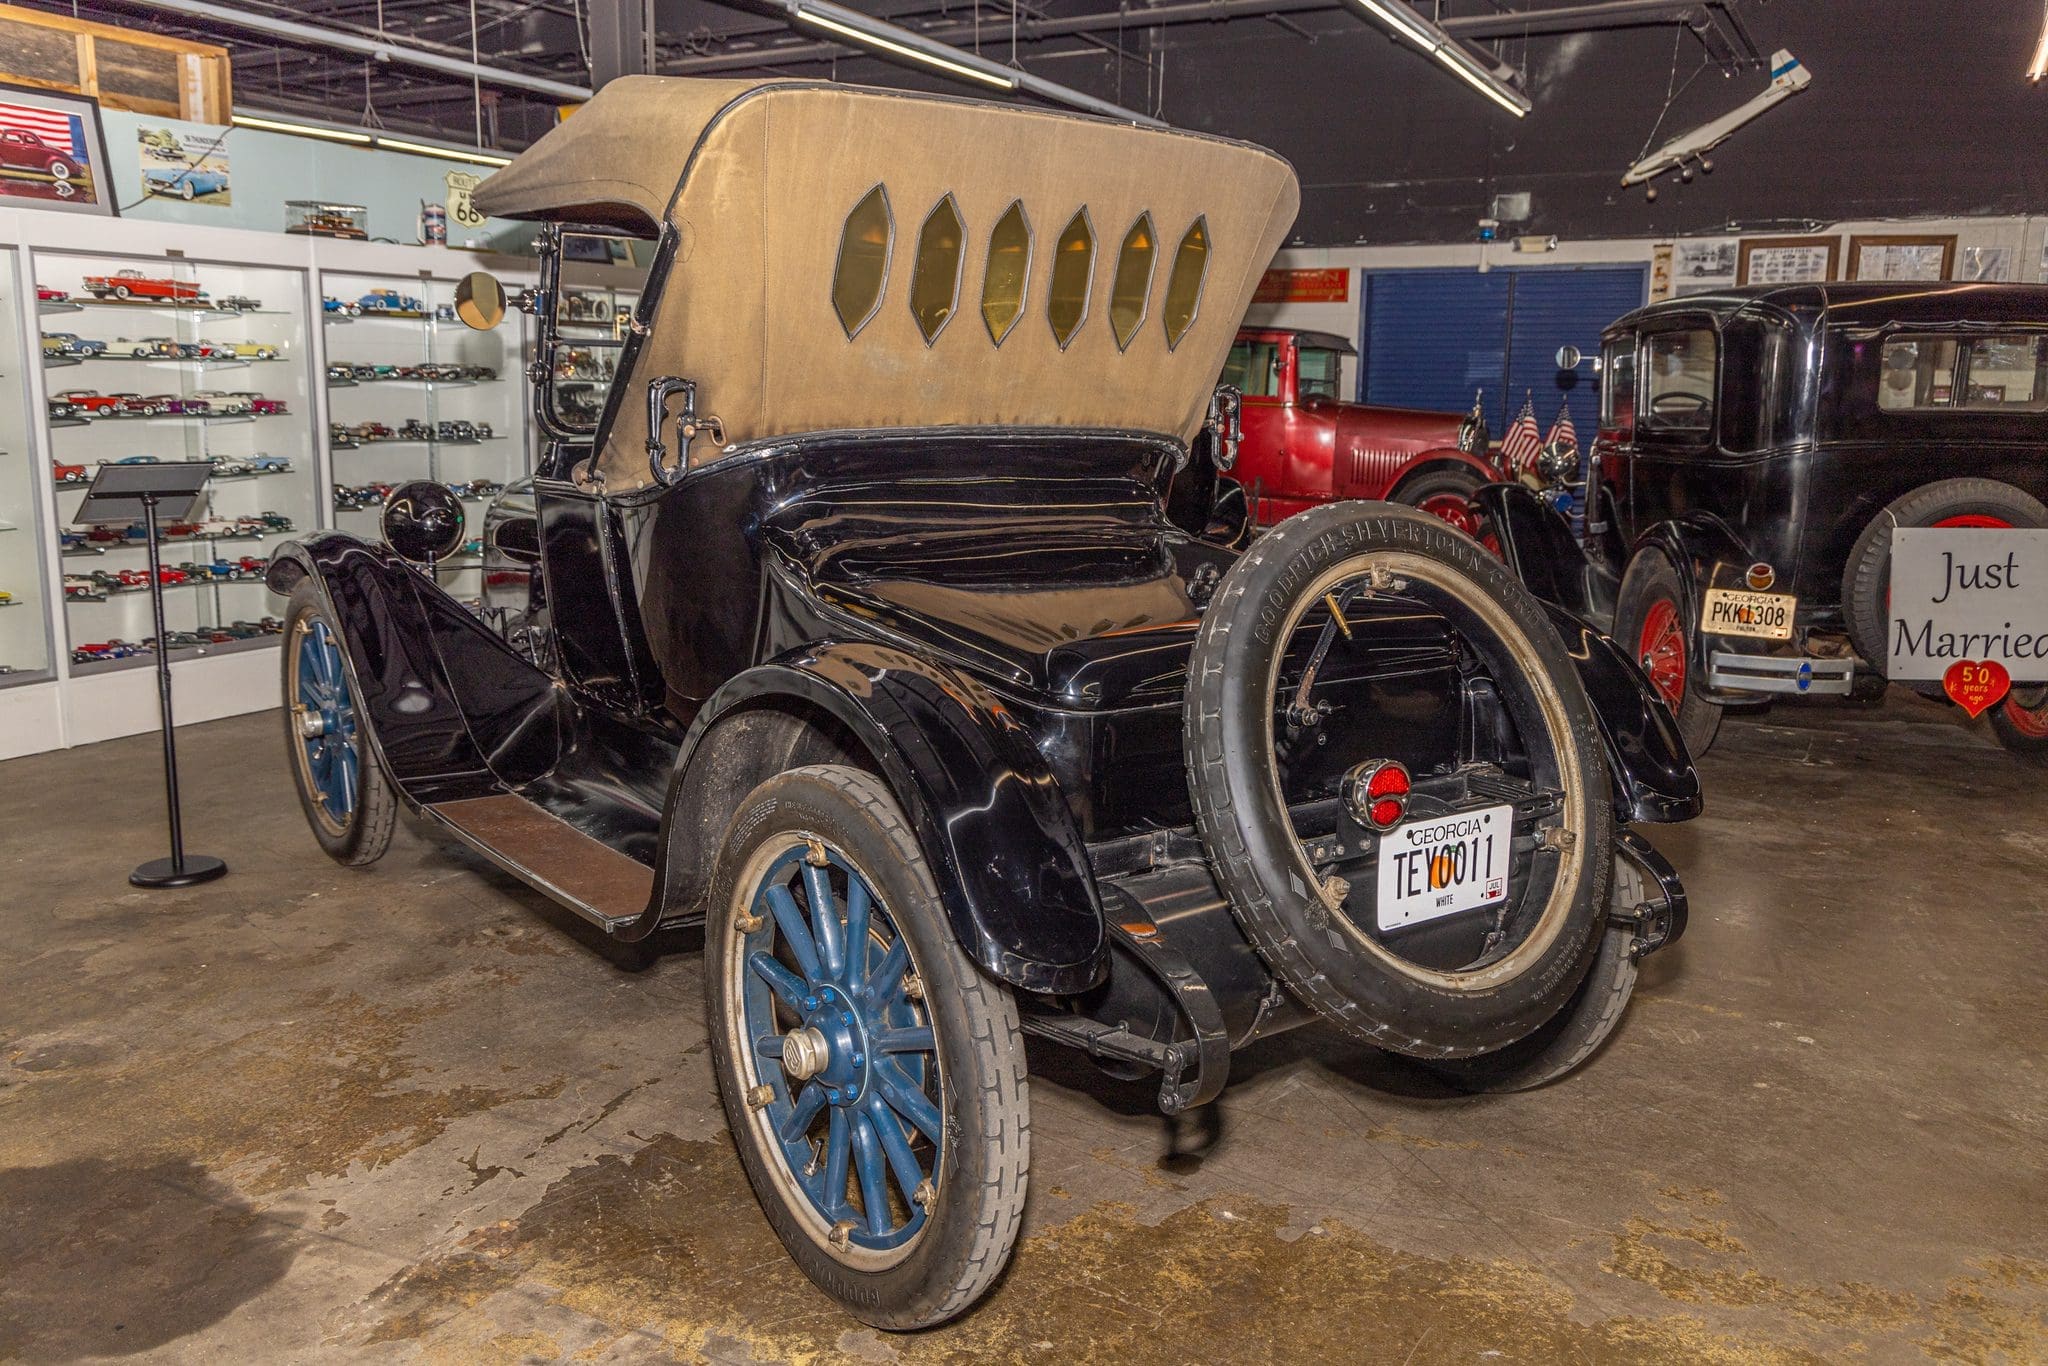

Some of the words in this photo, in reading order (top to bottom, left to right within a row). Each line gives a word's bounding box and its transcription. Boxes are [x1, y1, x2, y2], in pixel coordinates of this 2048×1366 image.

[457, 202, 479, 223] 66
[1254, 532, 1337, 645] GOODRICH
[1342, 519, 1482, 571] SILVERTOWN
[1932, 552, 2019, 603] Just
[1727, 593, 1774, 604] GEORGIA
[1712, 602, 1785, 627] PKK1308
[1962, 684, 1988, 695] years
[1969, 695, 1984, 705] ago
[1411, 818, 1481, 846] GEORGIA
[1393, 834, 1493, 900] TEY0011
[1436, 894, 1454, 907] WHITE
